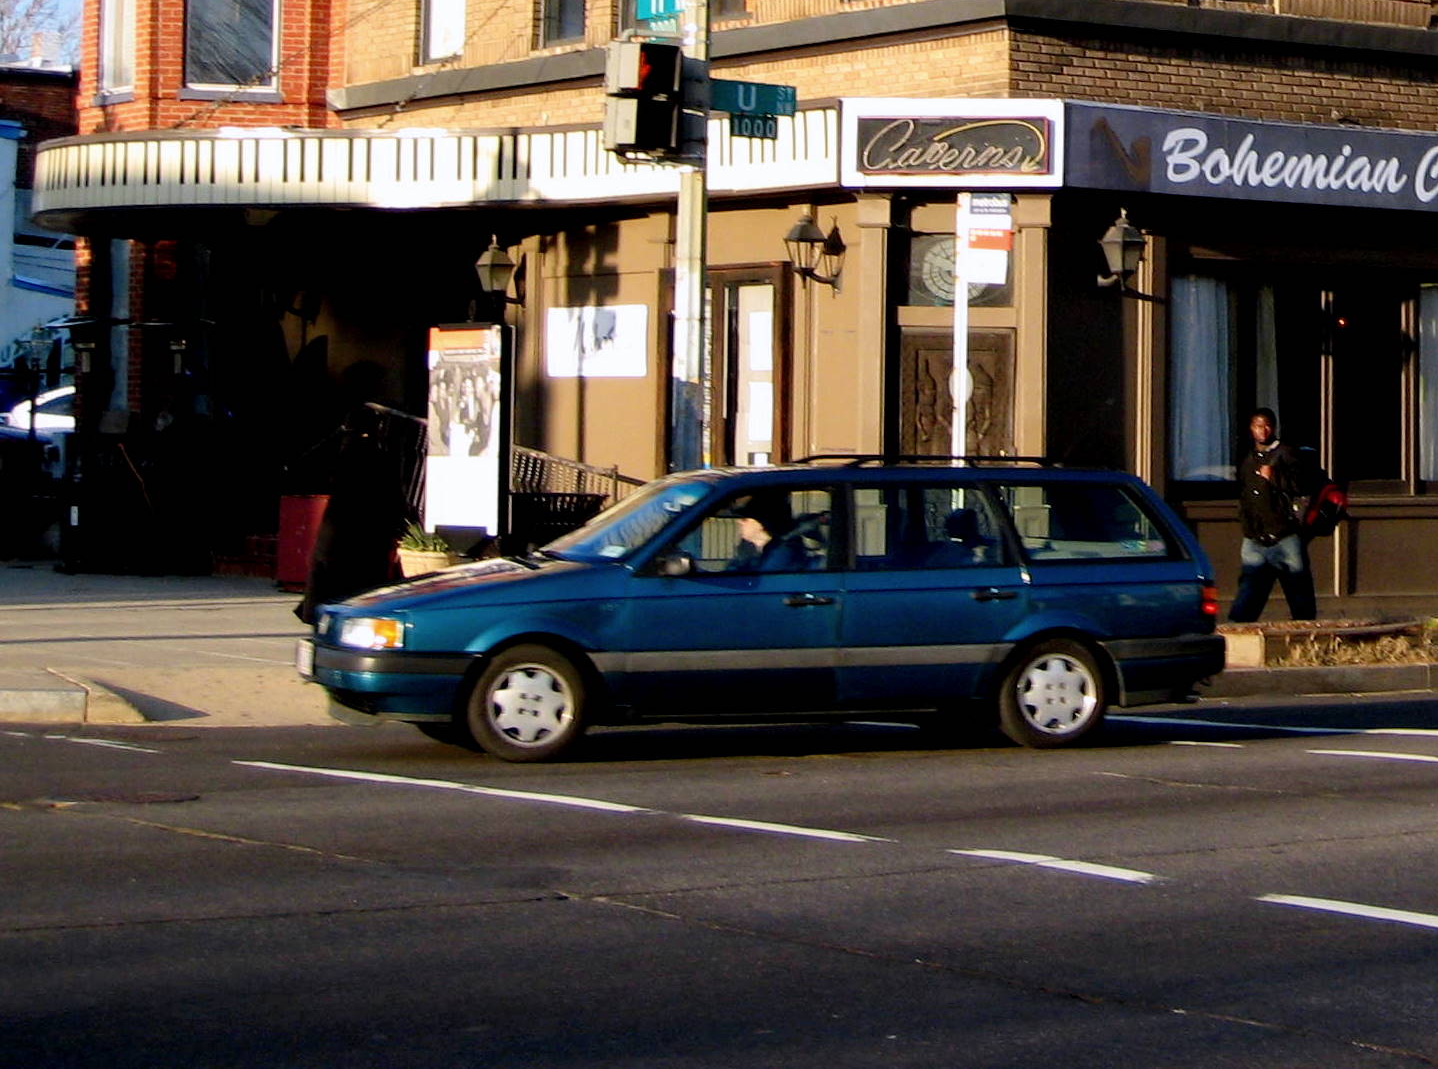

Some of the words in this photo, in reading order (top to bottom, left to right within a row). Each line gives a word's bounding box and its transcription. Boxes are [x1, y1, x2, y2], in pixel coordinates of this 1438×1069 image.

[737, 84, 757, 111] U
[734, 117, 777, 138] 1000
[863, 118, 1024, 170] Caverns
[1162, 127, 1408, 193] Bohemian
